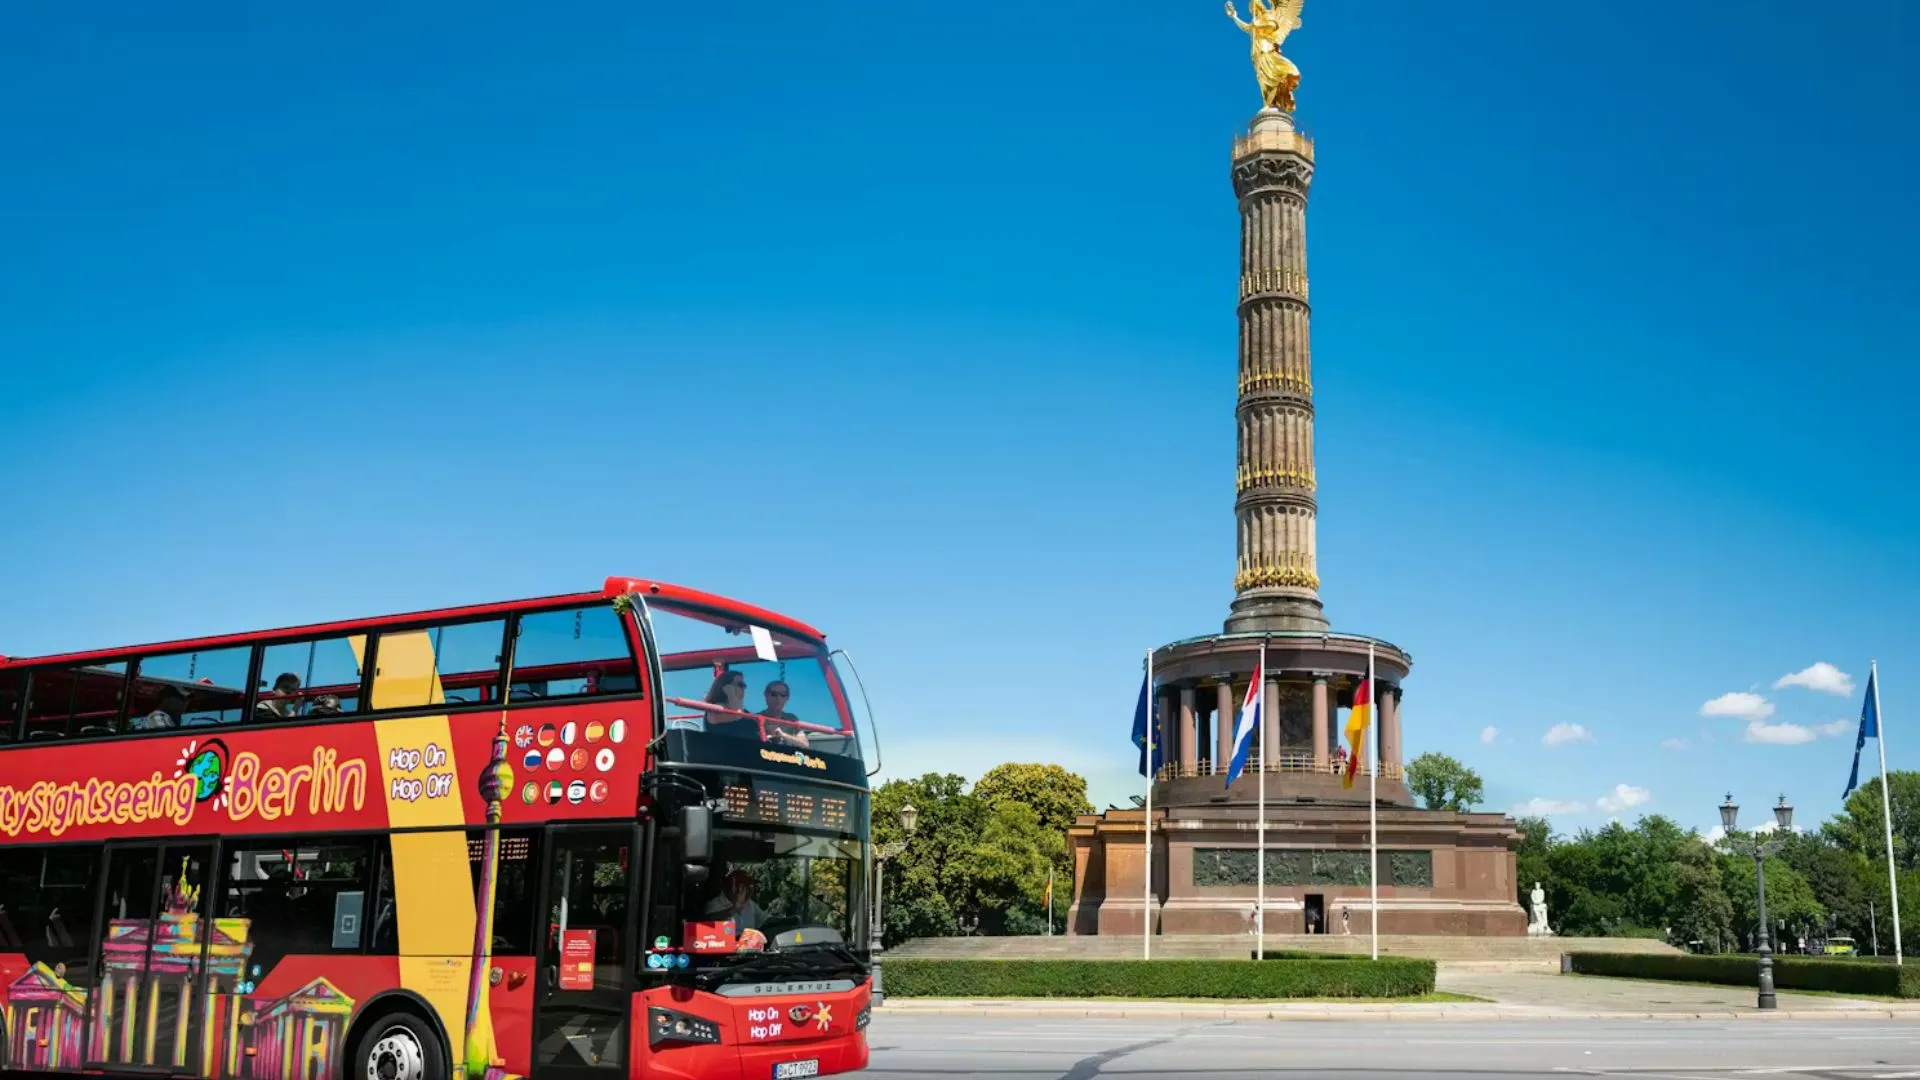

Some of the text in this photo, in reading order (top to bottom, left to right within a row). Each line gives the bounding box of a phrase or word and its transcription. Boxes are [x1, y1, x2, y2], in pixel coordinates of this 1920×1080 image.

[389, 743, 447, 772] Hop On
[228, 746, 367, 820] Berlin
[391, 772, 453, 803] Hop Off
[748, 1006, 779, 1022] Hop On
[751, 1023, 782, 1039] Hop Off
